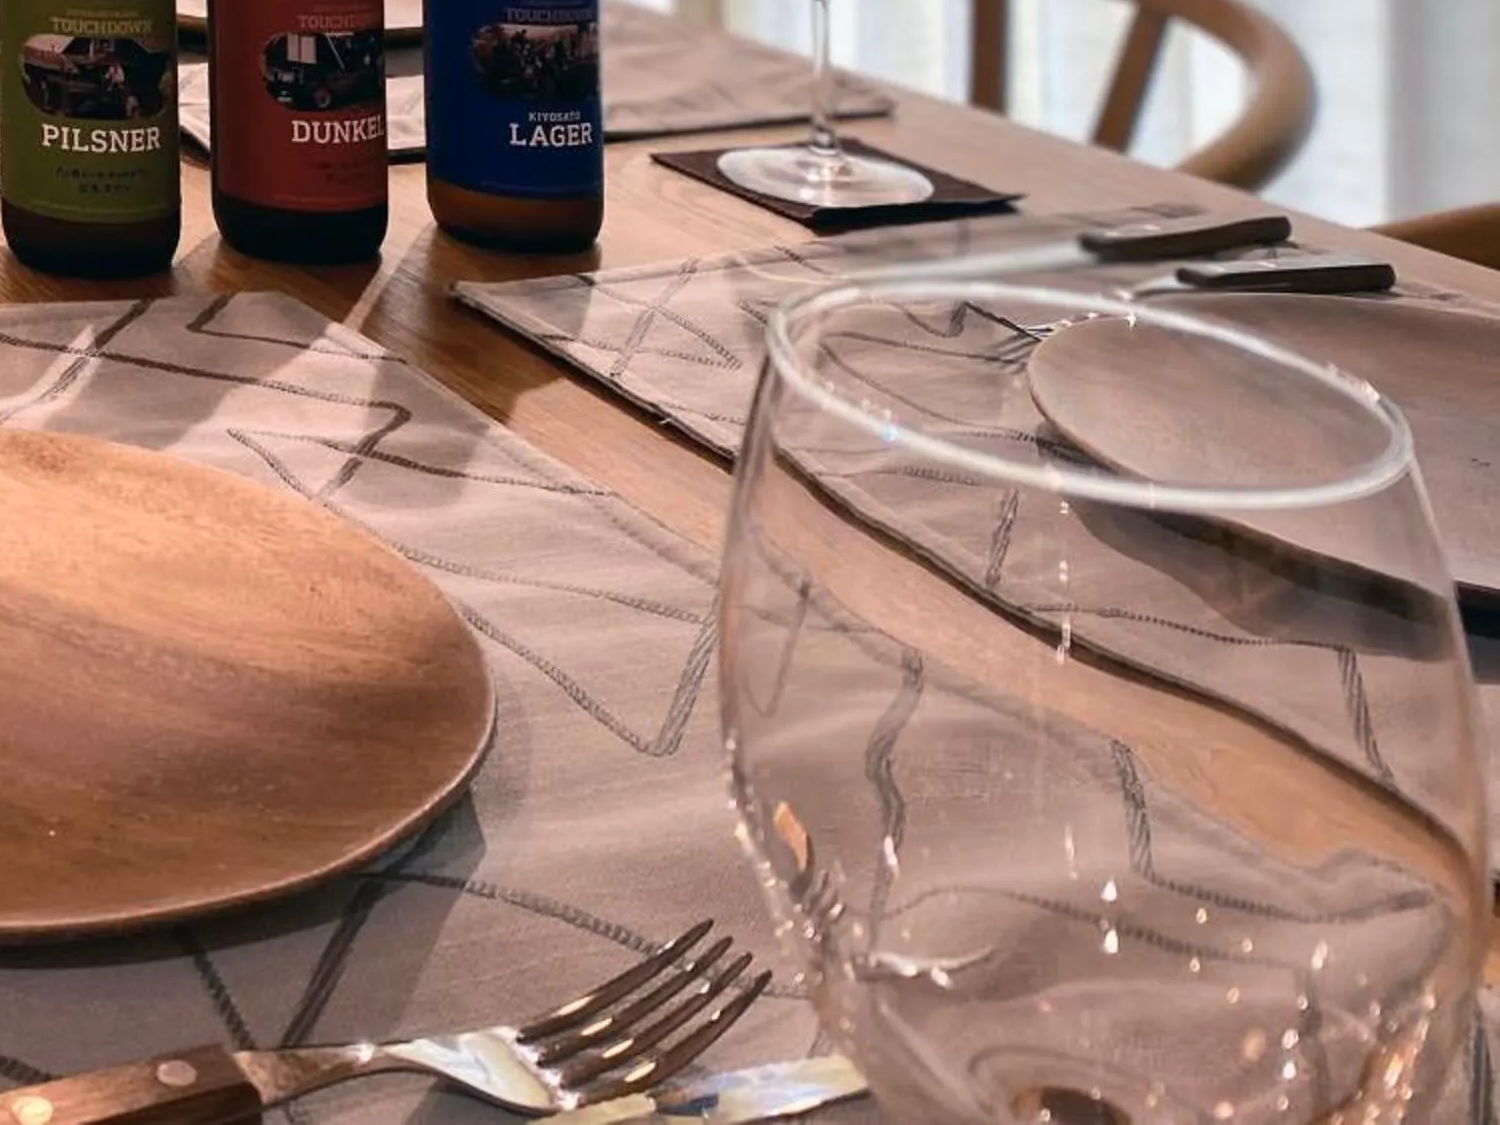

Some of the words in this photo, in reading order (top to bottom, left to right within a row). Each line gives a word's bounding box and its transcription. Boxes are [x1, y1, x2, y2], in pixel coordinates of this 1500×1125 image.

[49, 16, 153, 35] TOUCHDOWN
[40, 123, 161, 153] PILSNER
[291, 114, 384, 144] DUNKEL
[509, 122, 593, 148] LAGER
